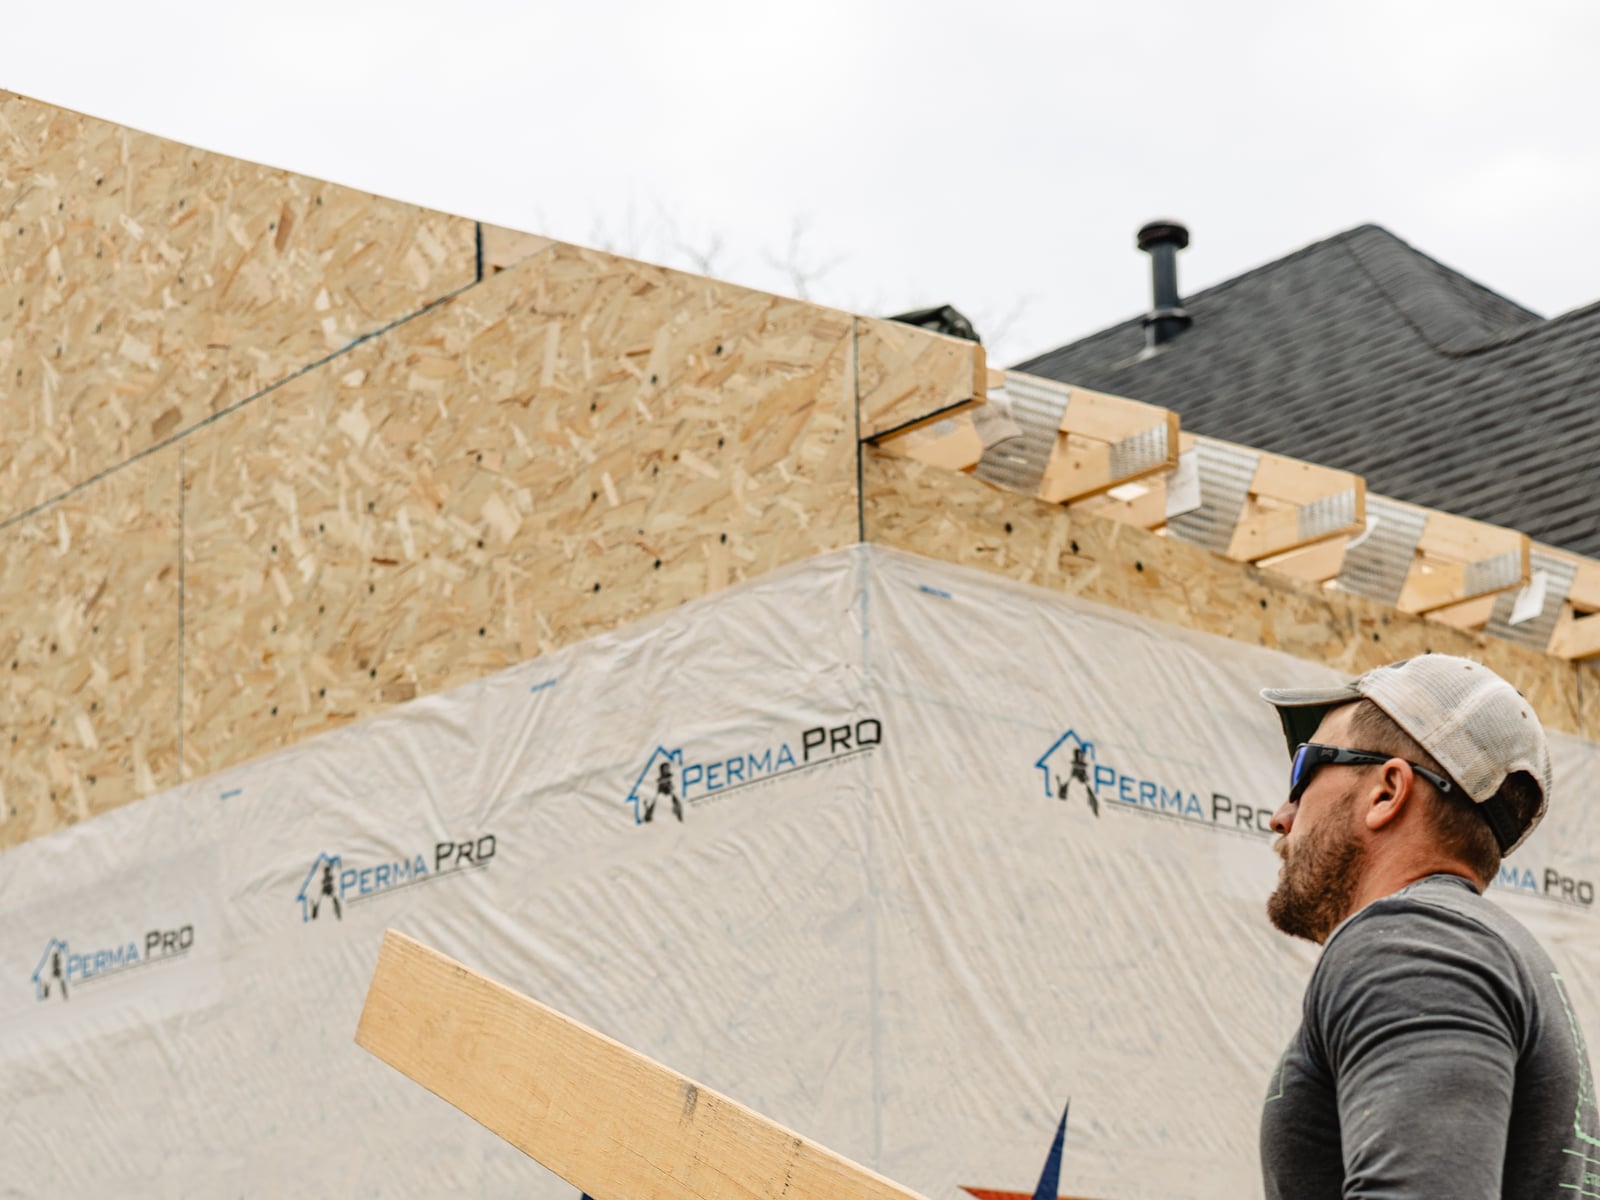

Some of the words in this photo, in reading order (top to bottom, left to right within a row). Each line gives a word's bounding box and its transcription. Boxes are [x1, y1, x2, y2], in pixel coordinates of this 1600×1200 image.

[682, 743, 796, 797] PERMA
[803, 718, 882, 762] PRO
[1094, 765, 1204, 819] PERMA
[339, 854, 430, 899] PERMA
[434, 834, 496, 871] PRO
[1543, 867, 1595, 905] PRO
[66, 943, 141, 980] PERMA
[145, 925, 194, 960] PRO
